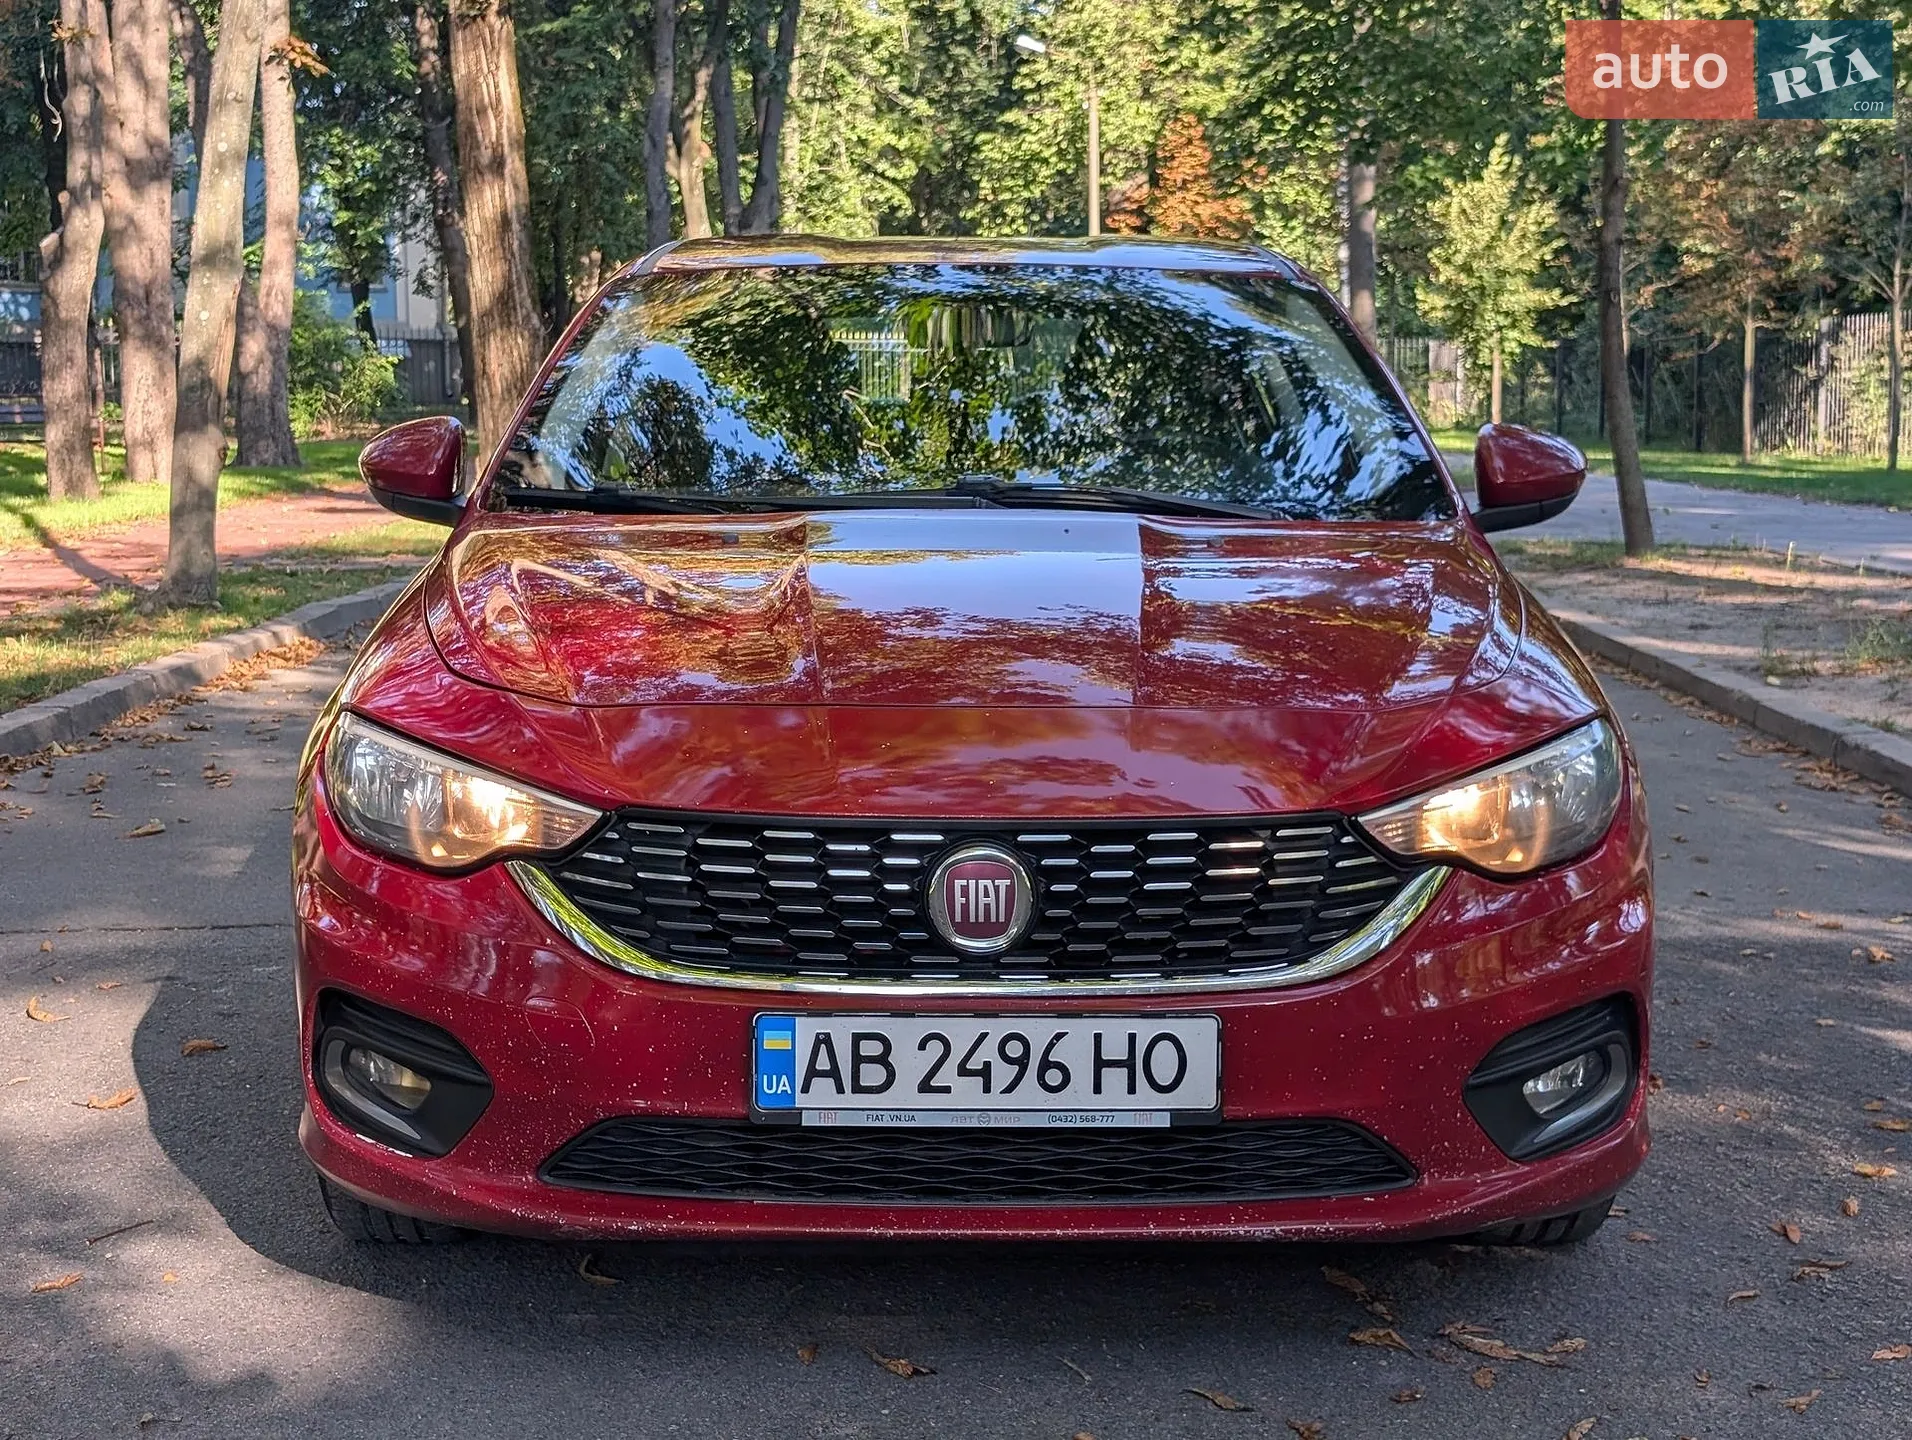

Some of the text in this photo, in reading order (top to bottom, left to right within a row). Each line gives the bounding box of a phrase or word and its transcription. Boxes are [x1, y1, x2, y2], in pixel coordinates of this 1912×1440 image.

[954, 879, 1011, 923] FIAT
[800, 1031, 1188, 1095] AB 2496 HO
[763, 1075, 792, 1095] UA
[818, 1111, 839, 1124] FIAT
[1047, 1113, 1116, 1125] (0432) 568-777
